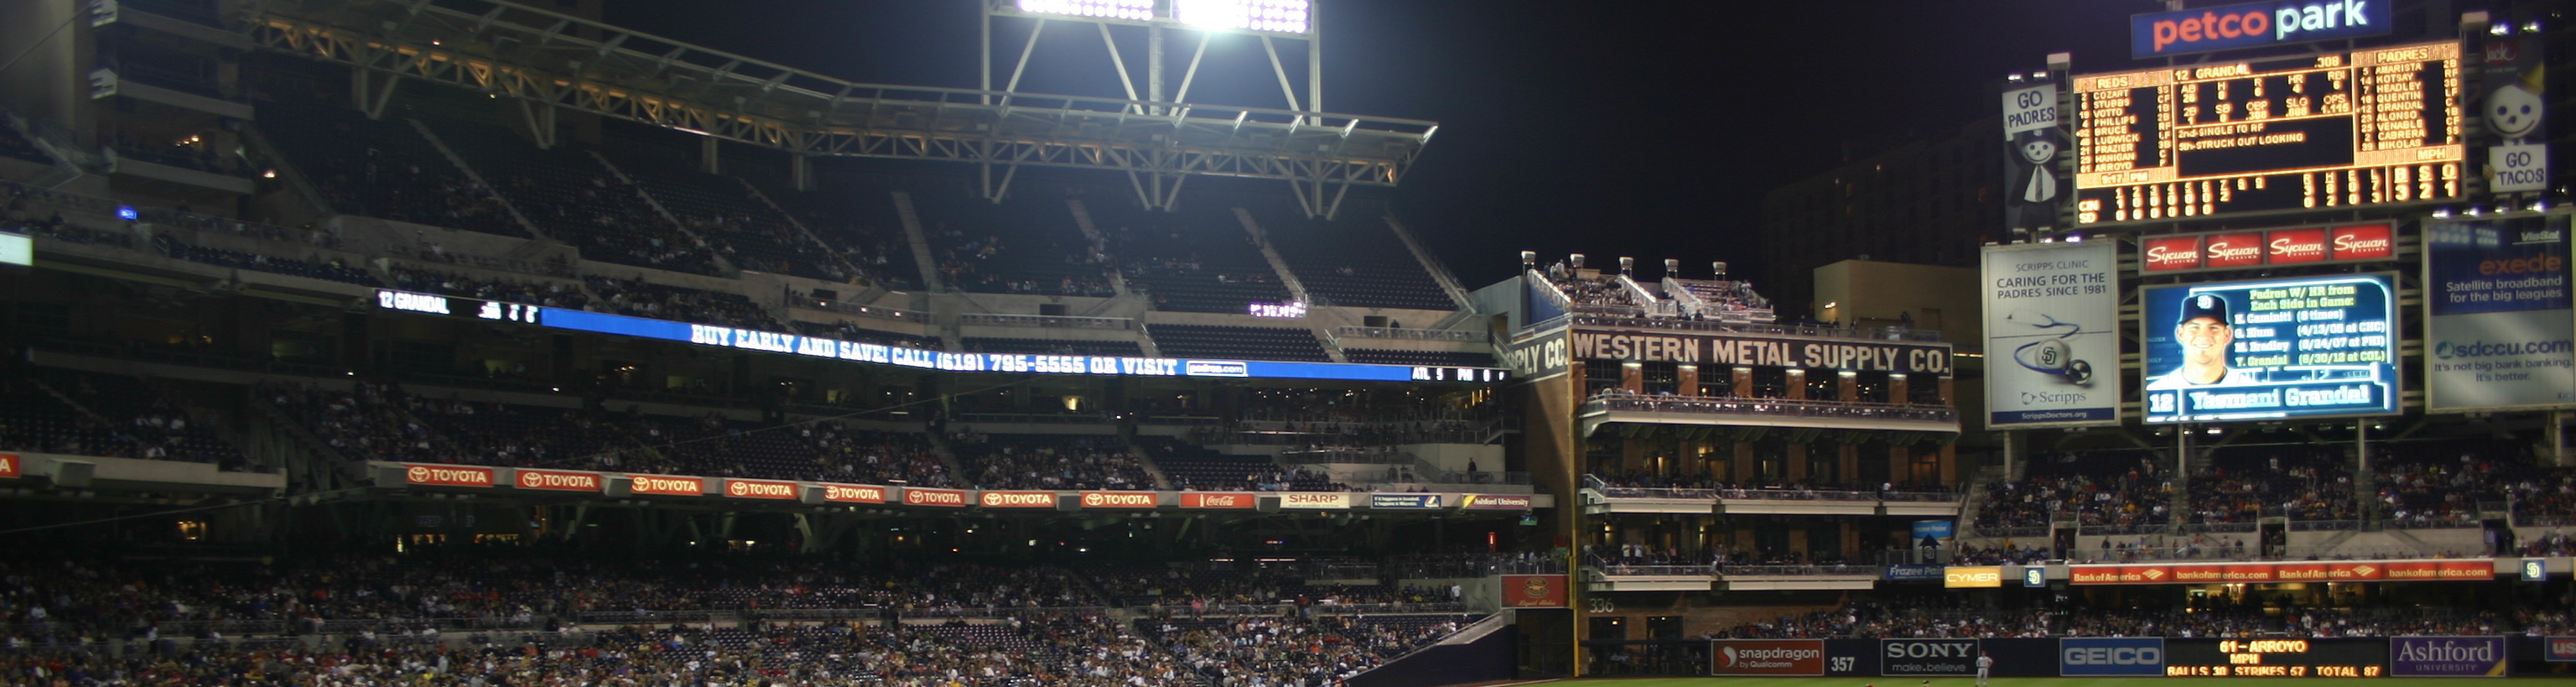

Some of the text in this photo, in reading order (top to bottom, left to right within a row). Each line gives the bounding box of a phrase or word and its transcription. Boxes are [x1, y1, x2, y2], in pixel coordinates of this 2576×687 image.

[2153, 0, 2368, 52] petco park
[2377, 49, 2428, 63] PADRES
[2175, 64, 2251, 81] 12 GRANDAL
[2376, 73, 2413, 84] KOTSAY
[2097, 77, 2128, 89] REDS
[2376, 81, 2421, 93] HEADLEY
[2018, 91, 2043, 109] GO
[2093, 89, 2129, 101] COZART
[2376, 91, 2421, 102] QUENTIN
[2094, 98, 2130, 109] STUBBS
[2377, 101, 2423, 112] GRANDAL
[2007, 107, 2055, 128] PADRES
[2093, 107, 2123, 117] VOTTO
[2376, 111, 2418, 122] ALONSO
[2094, 116, 2136, 127] PHILLIPS
[2376, 119, 2423, 131] VENABLE
[2095, 126, 2127, 136] BRUCE
[2378, 129, 2425, 141] CABRERA
[2095, 133, 2140, 145] LUDWICK
[2095, 143, 2133, 154] FRAZIER
[2417, 148, 2446, 160] MPH
[2506, 151, 2531, 168] GO
[2095, 161, 2132, 172] ARROYO
[2130, 172, 2148, 182] PM
[2496, 168, 2545, 185] TACOS
[2269, 238, 2323, 258] Sycuan
[2333, 234, 2388, 253] Sycuan
[2147, 246, 2199, 265] Sycuan
[2207, 242, 2261, 261] Sycuan
[2015, 259, 2089, 272] SCRIPPS CLINIC
[2479, 252, 2563, 276] exede
[1997, 273, 2106, 289] CARING FOR THE
[2446, 276, 2563, 292] Satellite broadband
[1997, 284, 2106, 299] PADRES SINCE 1981
[2249, 284, 2355, 300] Padres W/ HR from
[2449, 288, 2562, 303] for the big leagues
[379, 291, 450, 315] 12 GRANDAL
[2250, 297, 2355, 311] Each Side in Game:
[2309, 309, 2344, 320] times)
[2346, 323, 2357, 333] at
[691, 324, 1177, 376] BUY EARLY AND SAVE! CALL (619) 795-5555 OR VISIT
[1545, 337, 1569, 370] CO.
[1572, 333, 1950, 373] WESTERN METAL SUPPLY CO.
[2455, 340, 2572, 358] sdccu.com
[2247, 355, 2288, 367] Grandal
[2347, 352, 2358, 362] at
[2360, 350, 2385, 362] COL)
[2434, 357, 2573, 372] It's not big bank banking.
[1412, 367, 1431, 381] ATL
[1436, 367, 1444, 382] 5
[1457, 368, 1474, 382] PHI
[2475, 372, 2531, 383] It's better.
[2038, 391, 2087, 404] Scripps
[2149, 385, 2370, 413] 12 Yasmani Grandal
[2022, 411, 2088, 420] ScrippsDoctors.org
[430, 469, 487, 483] TOYOTA
[543, 474, 594, 488] TOYOTA
[651, 478, 698, 492] TOYOTA
[748, 483, 792, 497] TOYOTA
[839, 487, 880, 501] TOYOTA
[923, 492, 961, 504] TOYOTA
[1004, 493, 1051, 505] TOYOTA
[1104, 494, 1151, 505] TOYOTA
[1288, 494, 1339, 503] SHARP
[1473, 497, 1529, 507] Ashford University
[1946, 573, 1999, 583] CYMER
[2176, 570, 2268, 580] bankofamerica.com
[2388, 569, 2487, 577] bankofamerica.com
[1590, 598, 1614, 612] 336
[1738, 648, 1820, 660] snapdragon
[1887, 643, 1973, 658] SONY
[2064, 647, 2161, 665] GEICO
[2397, 641, 2493, 661] Ashford
[1749, 660, 1793, 669] Qualcomm
[1831, 657, 1856, 672] 357
[2230, 653, 2260, 664] MPH
[1892, 663, 1966, 673] make.believe
[2235, 666, 2286, 677] STRIKES
[2315, 666, 2359, 677] TOTAL
[2363, 666, 2381, 677] 87
[2416, 664, 2475, 672] UNIVERSITY
